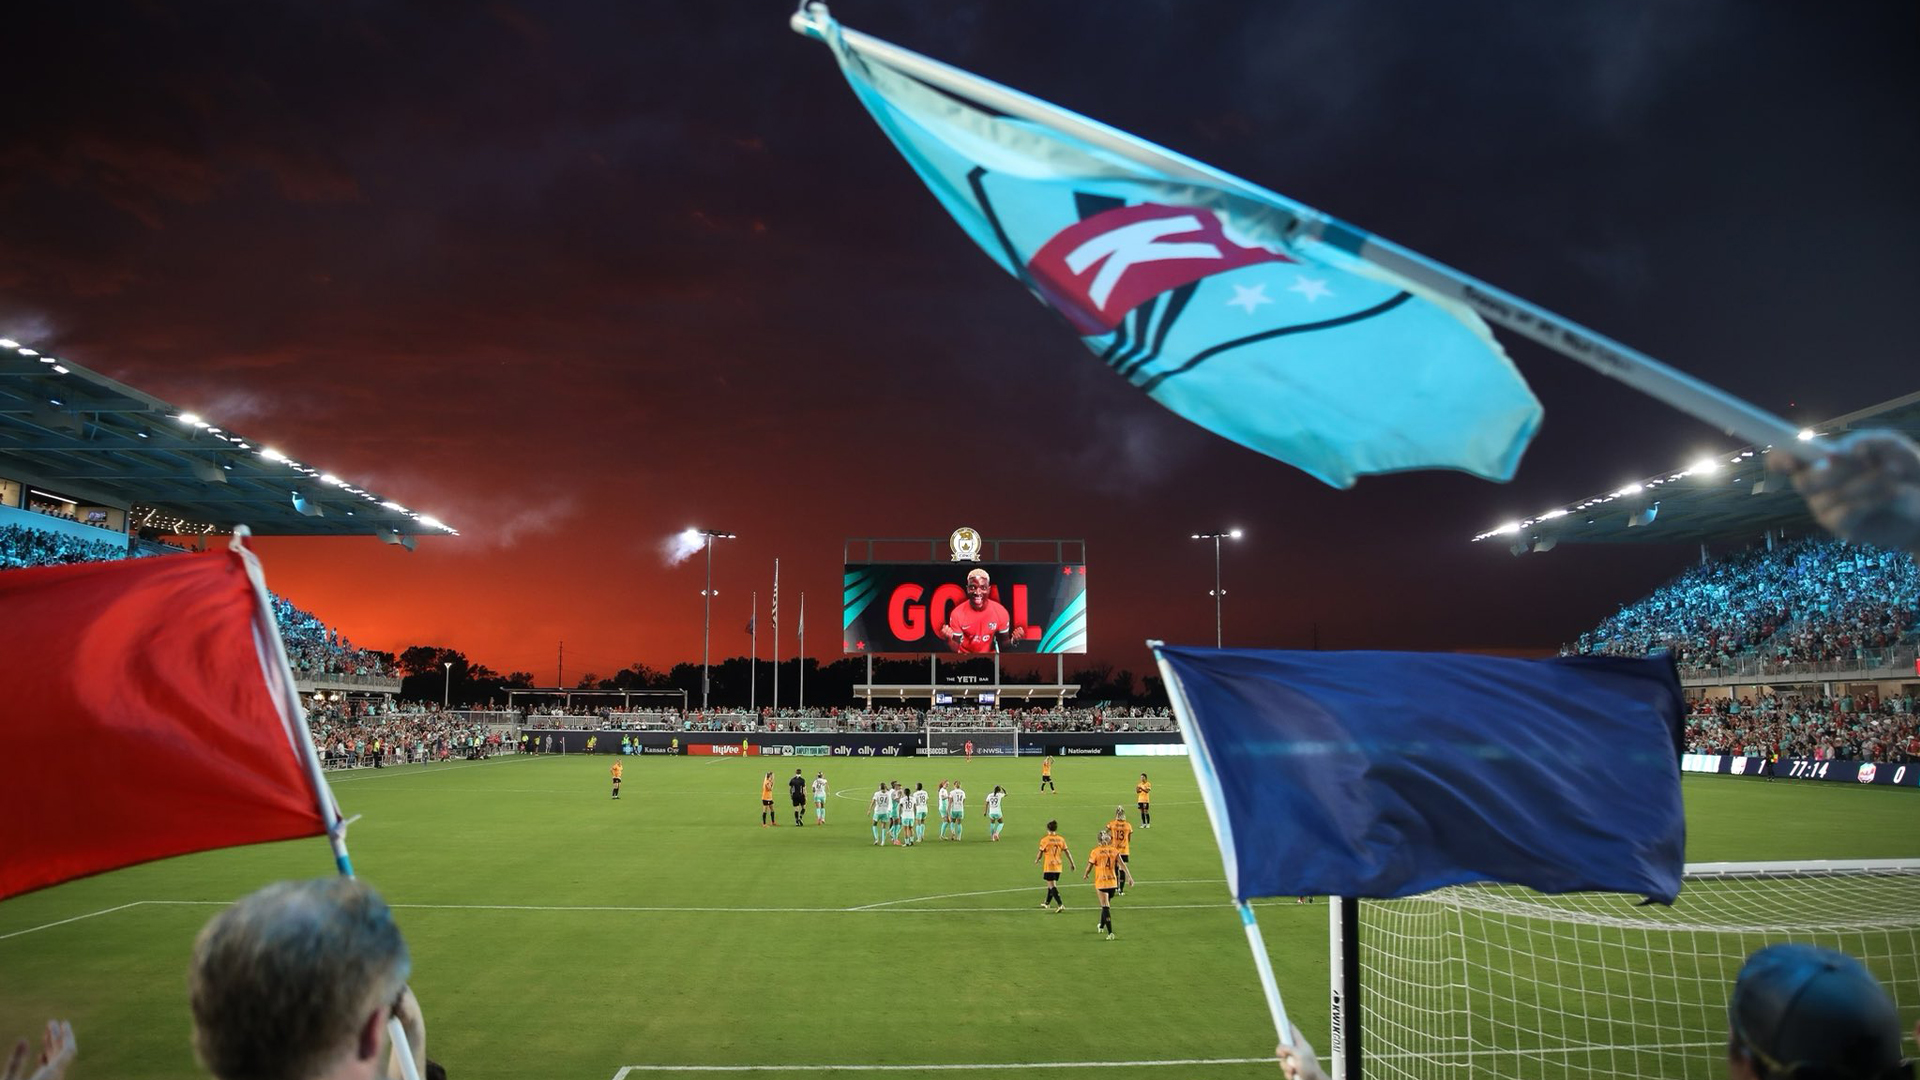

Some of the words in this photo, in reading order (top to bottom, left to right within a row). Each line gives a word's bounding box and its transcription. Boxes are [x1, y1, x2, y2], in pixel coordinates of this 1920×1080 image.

[957, 675, 977, 683] YETI
[644, 745, 666, 753] Kansas
[834, 745, 852, 756] ally
[857, 745, 876, 756] ally
[881, 745, 900, 756] ally
[1758, 759, 1766, 774] 1
[1789, 760, 1829, 778] 77:14
[1893, 765, 1906, 784] 0
[1116, 830, 1125, 841] 13
[1105, 857, 1111, 870] 4
